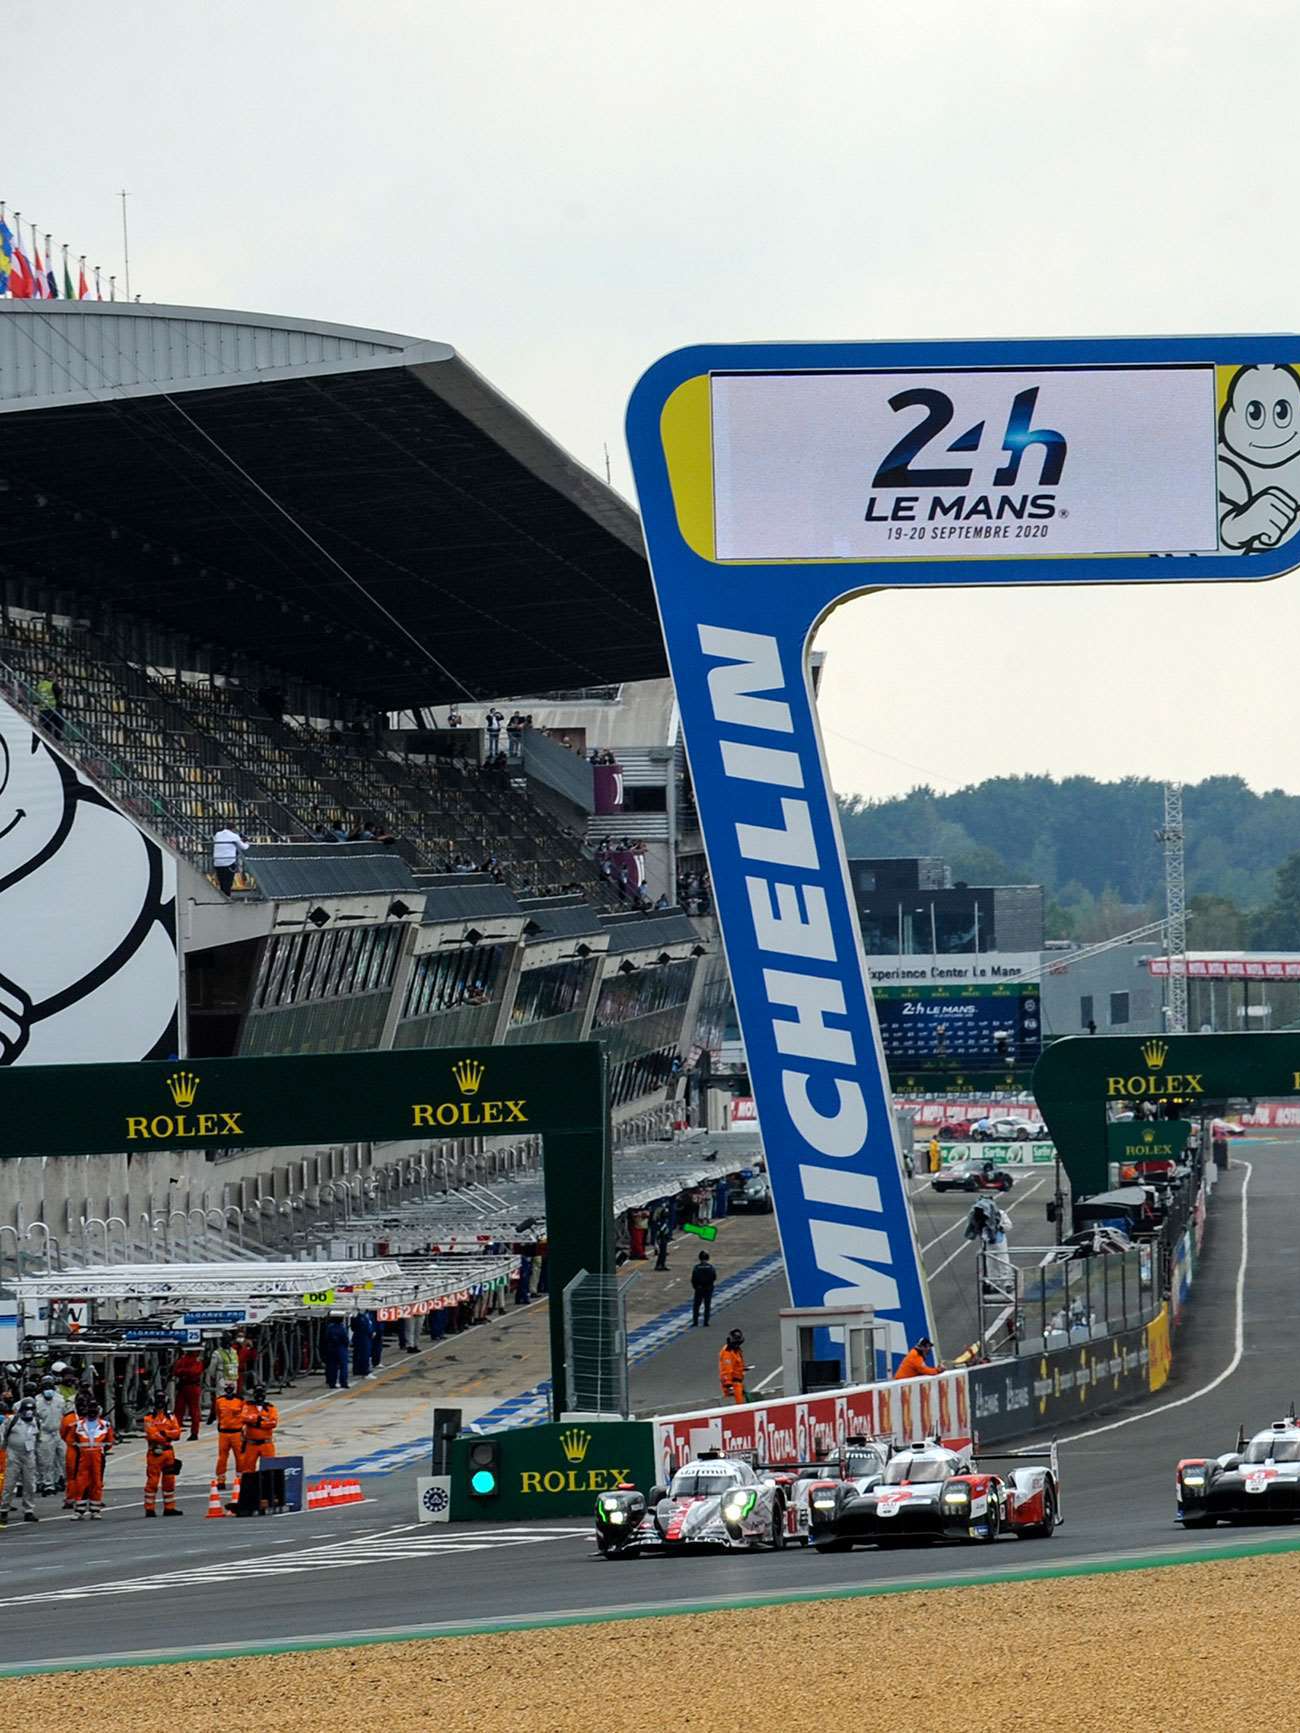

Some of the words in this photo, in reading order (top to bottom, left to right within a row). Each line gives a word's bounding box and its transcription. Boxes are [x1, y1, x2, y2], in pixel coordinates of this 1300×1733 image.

[872, 386, 1067, 488] 24h
[865, 497, 919, 522] LE
[928, 494, 1056, 522] MANS
[887, 527, 926, 540] 19-20
[931, 526, 1010, 540] SEPTEMBRE
[1016, 525, 1049, 538] 2020
[868, 967, 926, 981] xperience
[991, 966, 1022, 977] Mans
[696, 623, 909, 1355] MICHELIN
[927, 1006, 941, 1014] LE
[942, 1005, 977, 1014] MANS
[1107, 1074, 1202, 1095] ROLEX
[126, 1112, 243, 1139] ROLEX
[411, 1100, 528, 1127] ROLEX
[1126, 1144, 1172, 1155] ROLEX
[768, 1423, 796, 1461] TOTAL
[520, 1469, 630, 1493] ROLEX
